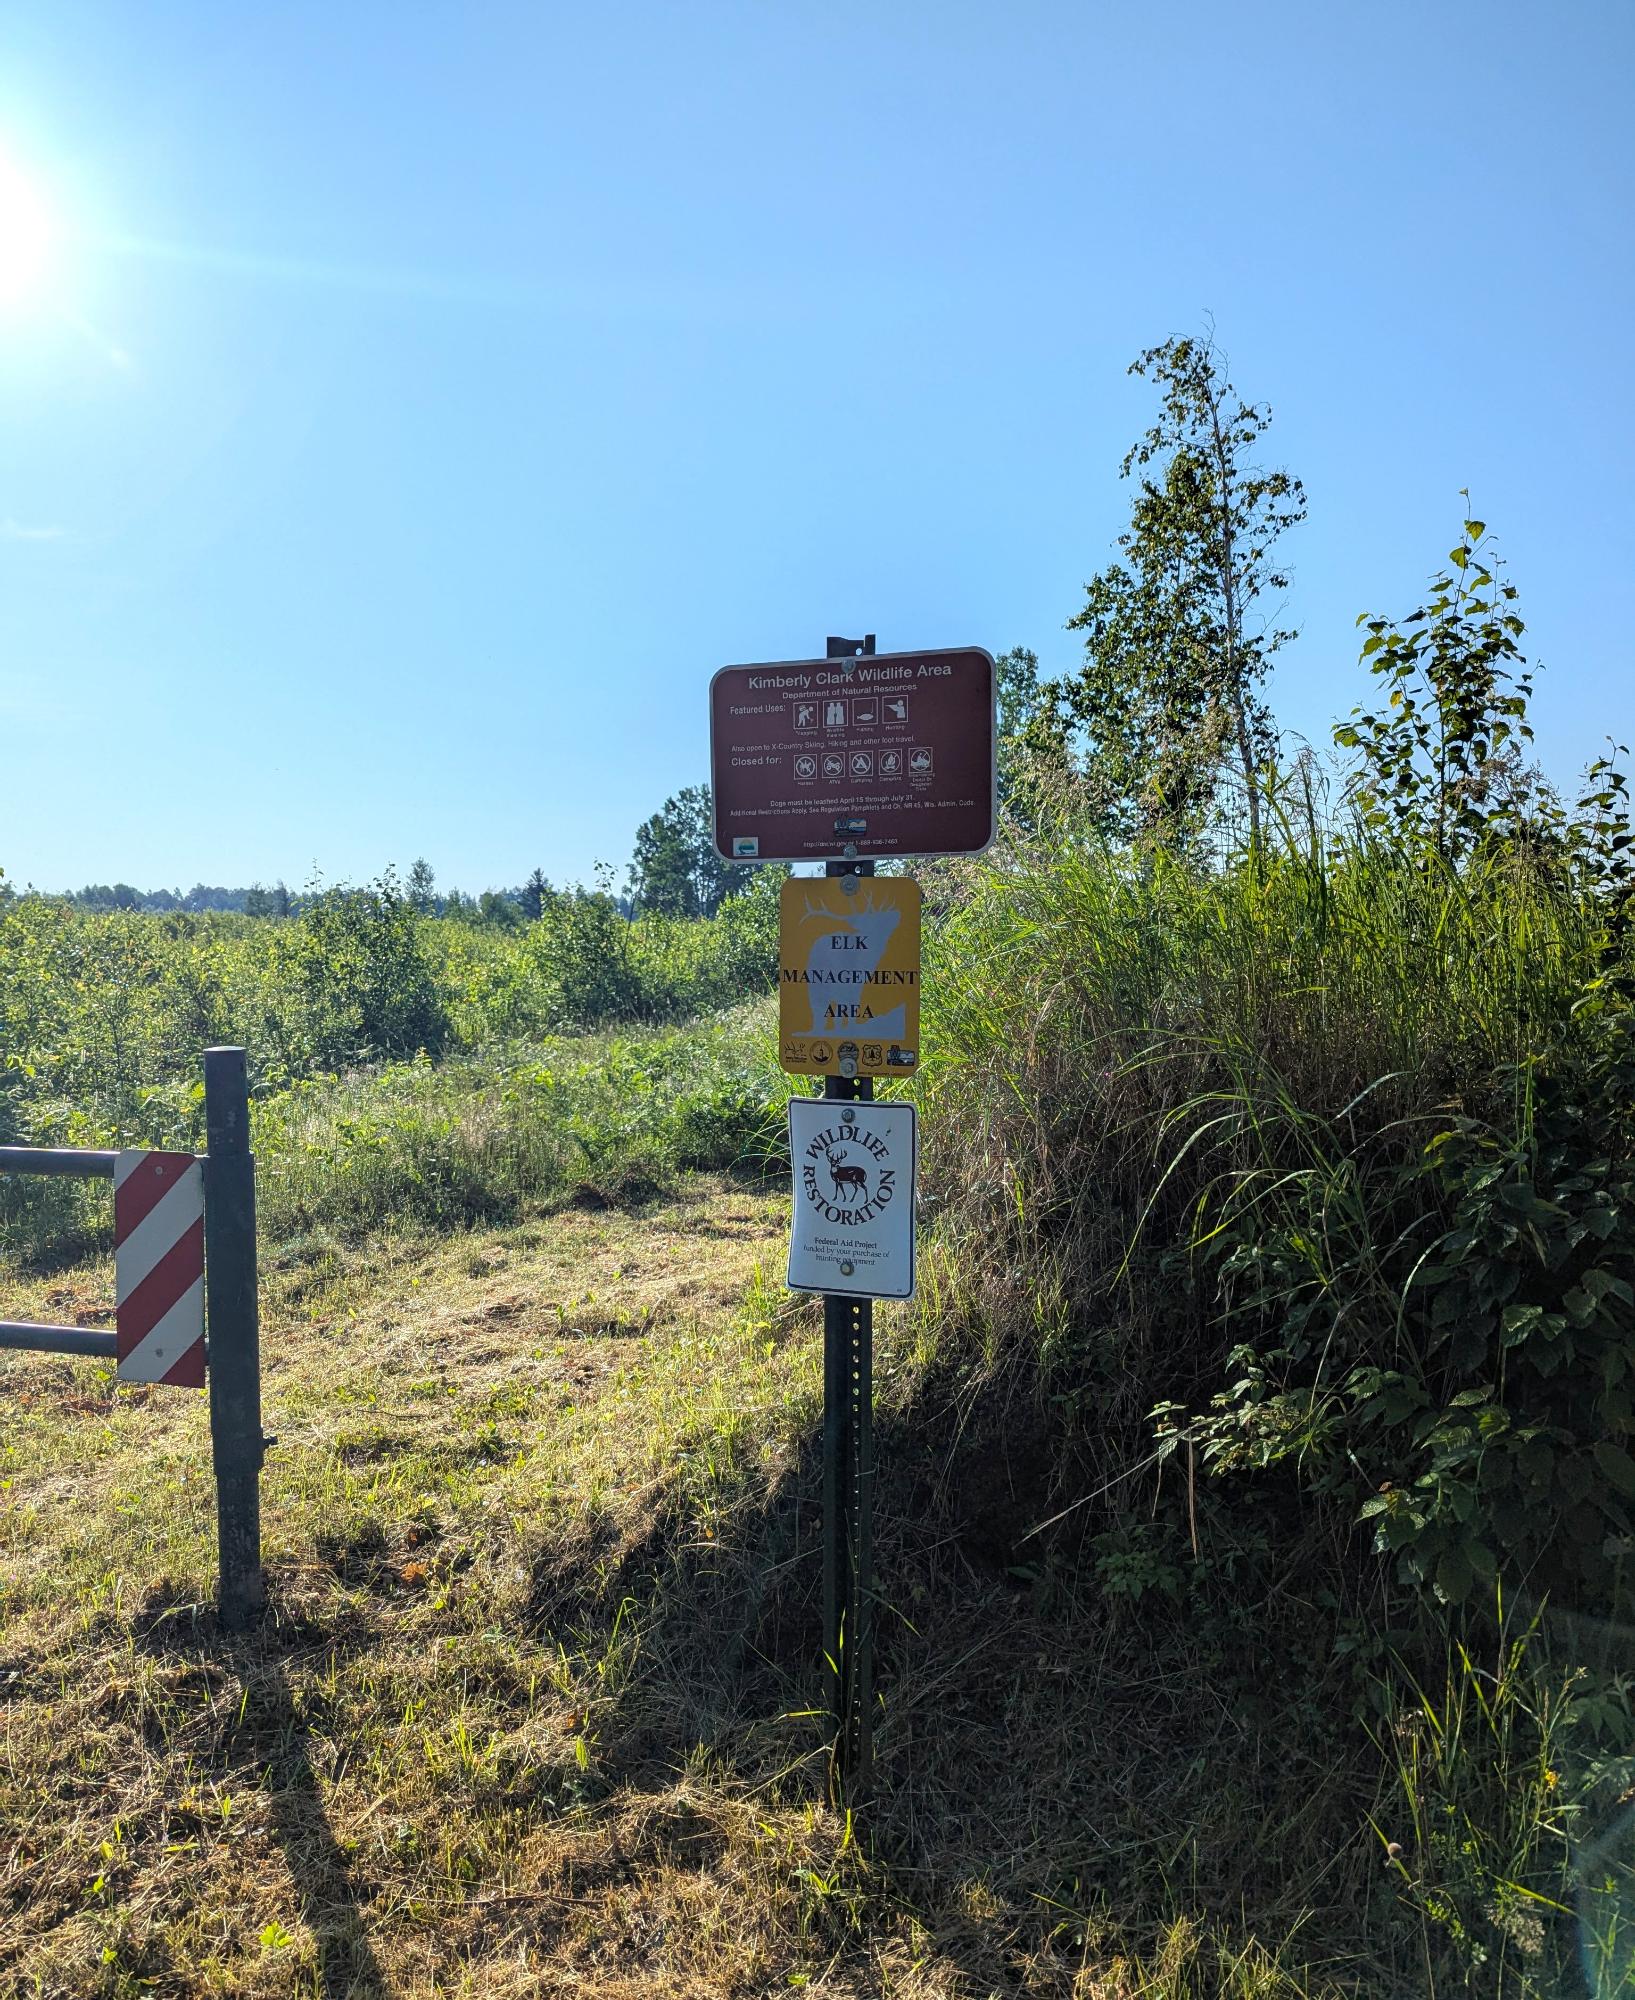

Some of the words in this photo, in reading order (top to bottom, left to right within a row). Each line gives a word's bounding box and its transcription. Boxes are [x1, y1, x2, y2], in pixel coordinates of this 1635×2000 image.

[749, 674, 811, 688] Kimberly
[816, 672, 853, 684] Clark
[858, 666, 912, 681] Wildlife
[917, 664, 952, 677] Area
[782, 690, 829, 700] Department
[842, 686, 871, 695] Natural
[874, 684, 918, 693] Resources
[730, 705, 762, 714] Featured
[766, 704, 786, 712] Uses:
[828, 740, 848, 748] Hiking
[882, 736, 894, 744] foot
[731, 757, 763, 766] Closed
[766, 756, 782, 764] for:
[865, 796, 889, 804] through
[830, 935, 868, 950] ELK
[783, 969, 918, 985] MANAGEMENT
[824, 1004, 874, 1018] AREA
[806, 1124, 890, 1162] WILDLIFE
[803, 1164, 896, 1226] RESTORATION
[814, 1237, 838, 1246] Federal
[854, 1240, 877, 1249] Project
[804, 1244, 824, 1253] funded
[826, 1246, 834, 1255] by
[852, 1250, 882, 1258] purchase
[816, 1254, 840, 1264] hunting
